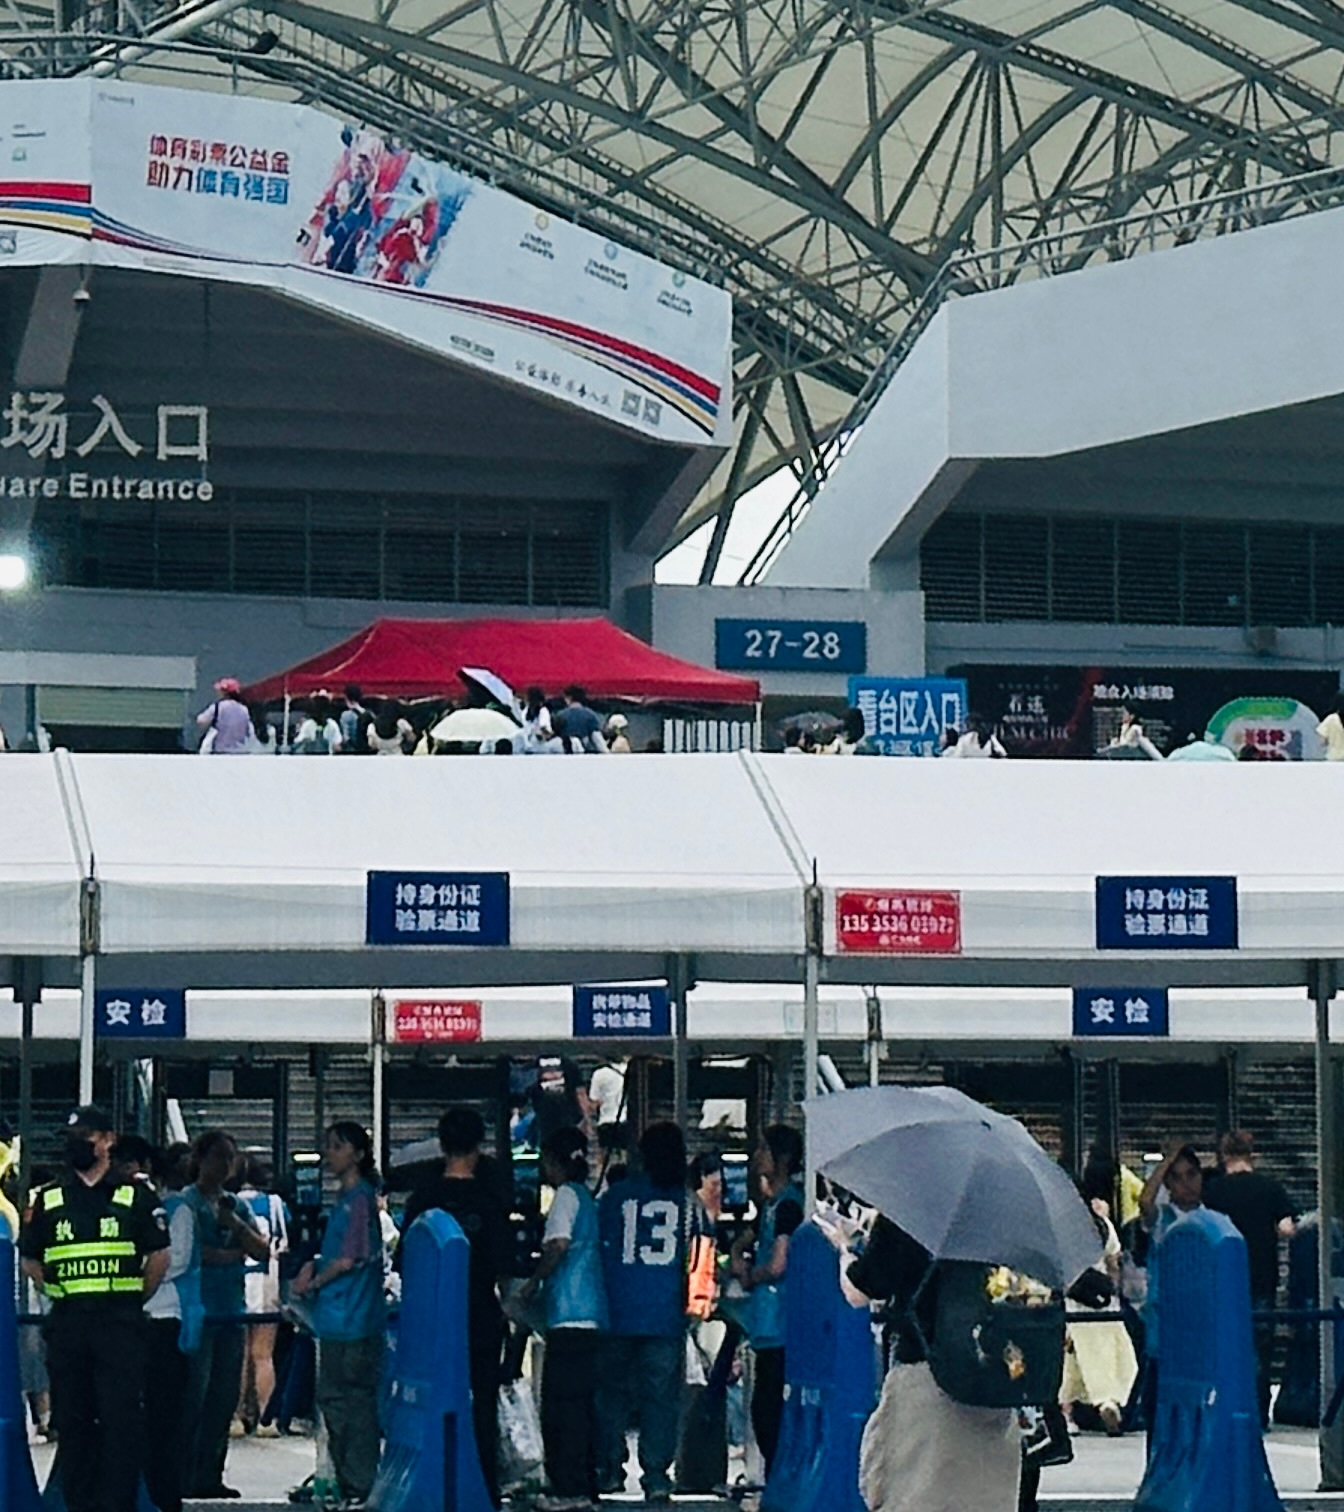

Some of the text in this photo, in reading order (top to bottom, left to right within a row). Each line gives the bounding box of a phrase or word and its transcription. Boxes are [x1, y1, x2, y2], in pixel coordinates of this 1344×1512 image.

[150, 134, 289, 175] 体育彩票公益金
[147, 160, 289, 204] 助力体育强国
[68, 473, 214, 501] Entrance
[744, 630, 841, 659] 27-28
[857, 689, 960, 736] 看台区入口
[396, 883, 481, 906] 持身份证
[1125, 888, 1208, 910] 持身份证
[106, 999, 167, 1026] 安检
[1090, 998, 1150, 1025] 安检
[622, 1199, 679, 1266] 13
[57, 1258, 120, 1278] ZHIQIN
